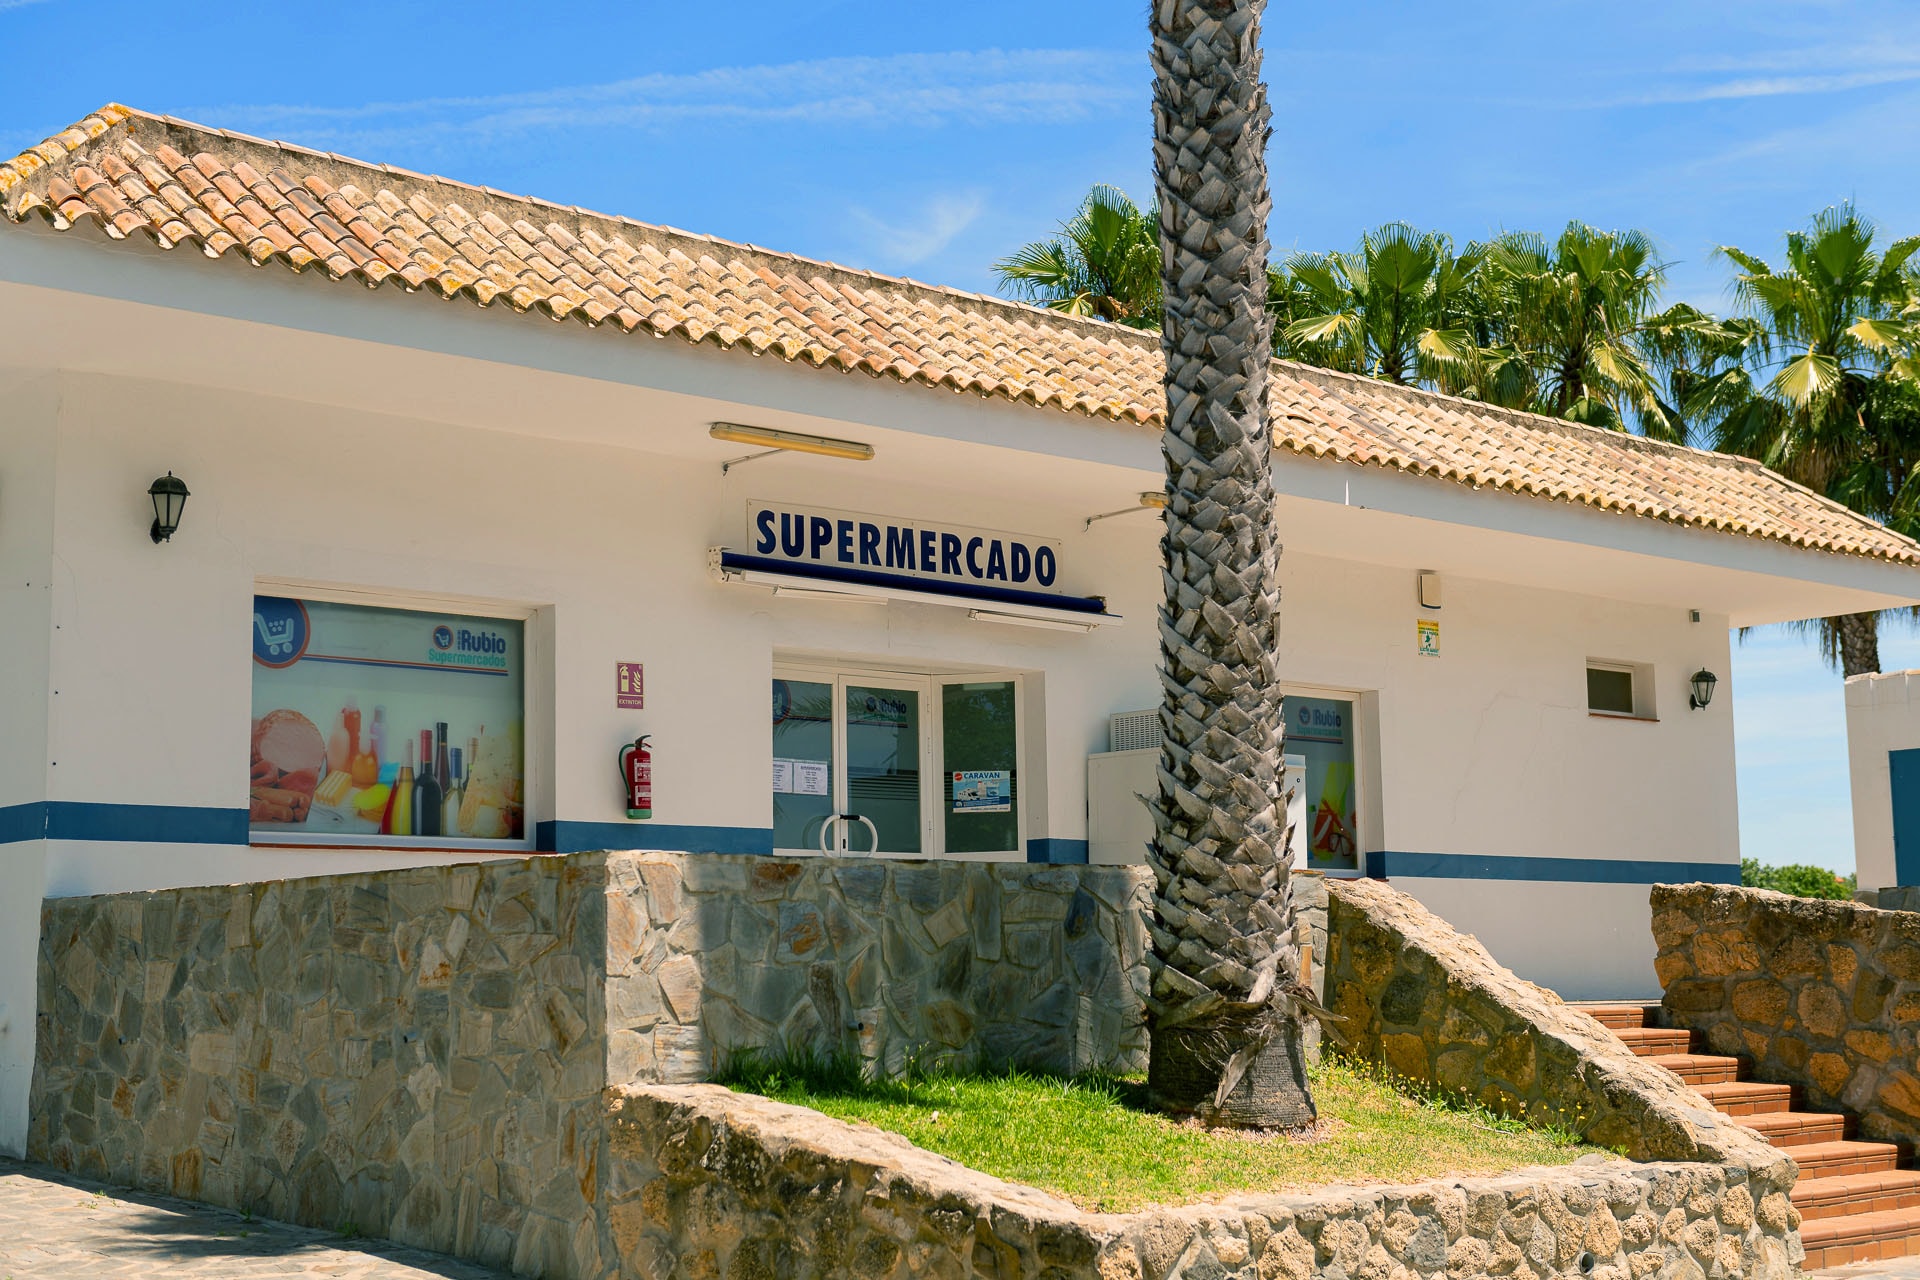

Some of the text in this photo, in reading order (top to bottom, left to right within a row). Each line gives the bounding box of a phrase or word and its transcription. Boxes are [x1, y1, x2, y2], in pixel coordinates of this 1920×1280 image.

[756, 509, 1056, 587] SUPERMERCADO
[461, 629, 506, 654] Rubio
[428, 648, 506, 667] Supermercados
[1314, 709, 1341, 728] Rubio
